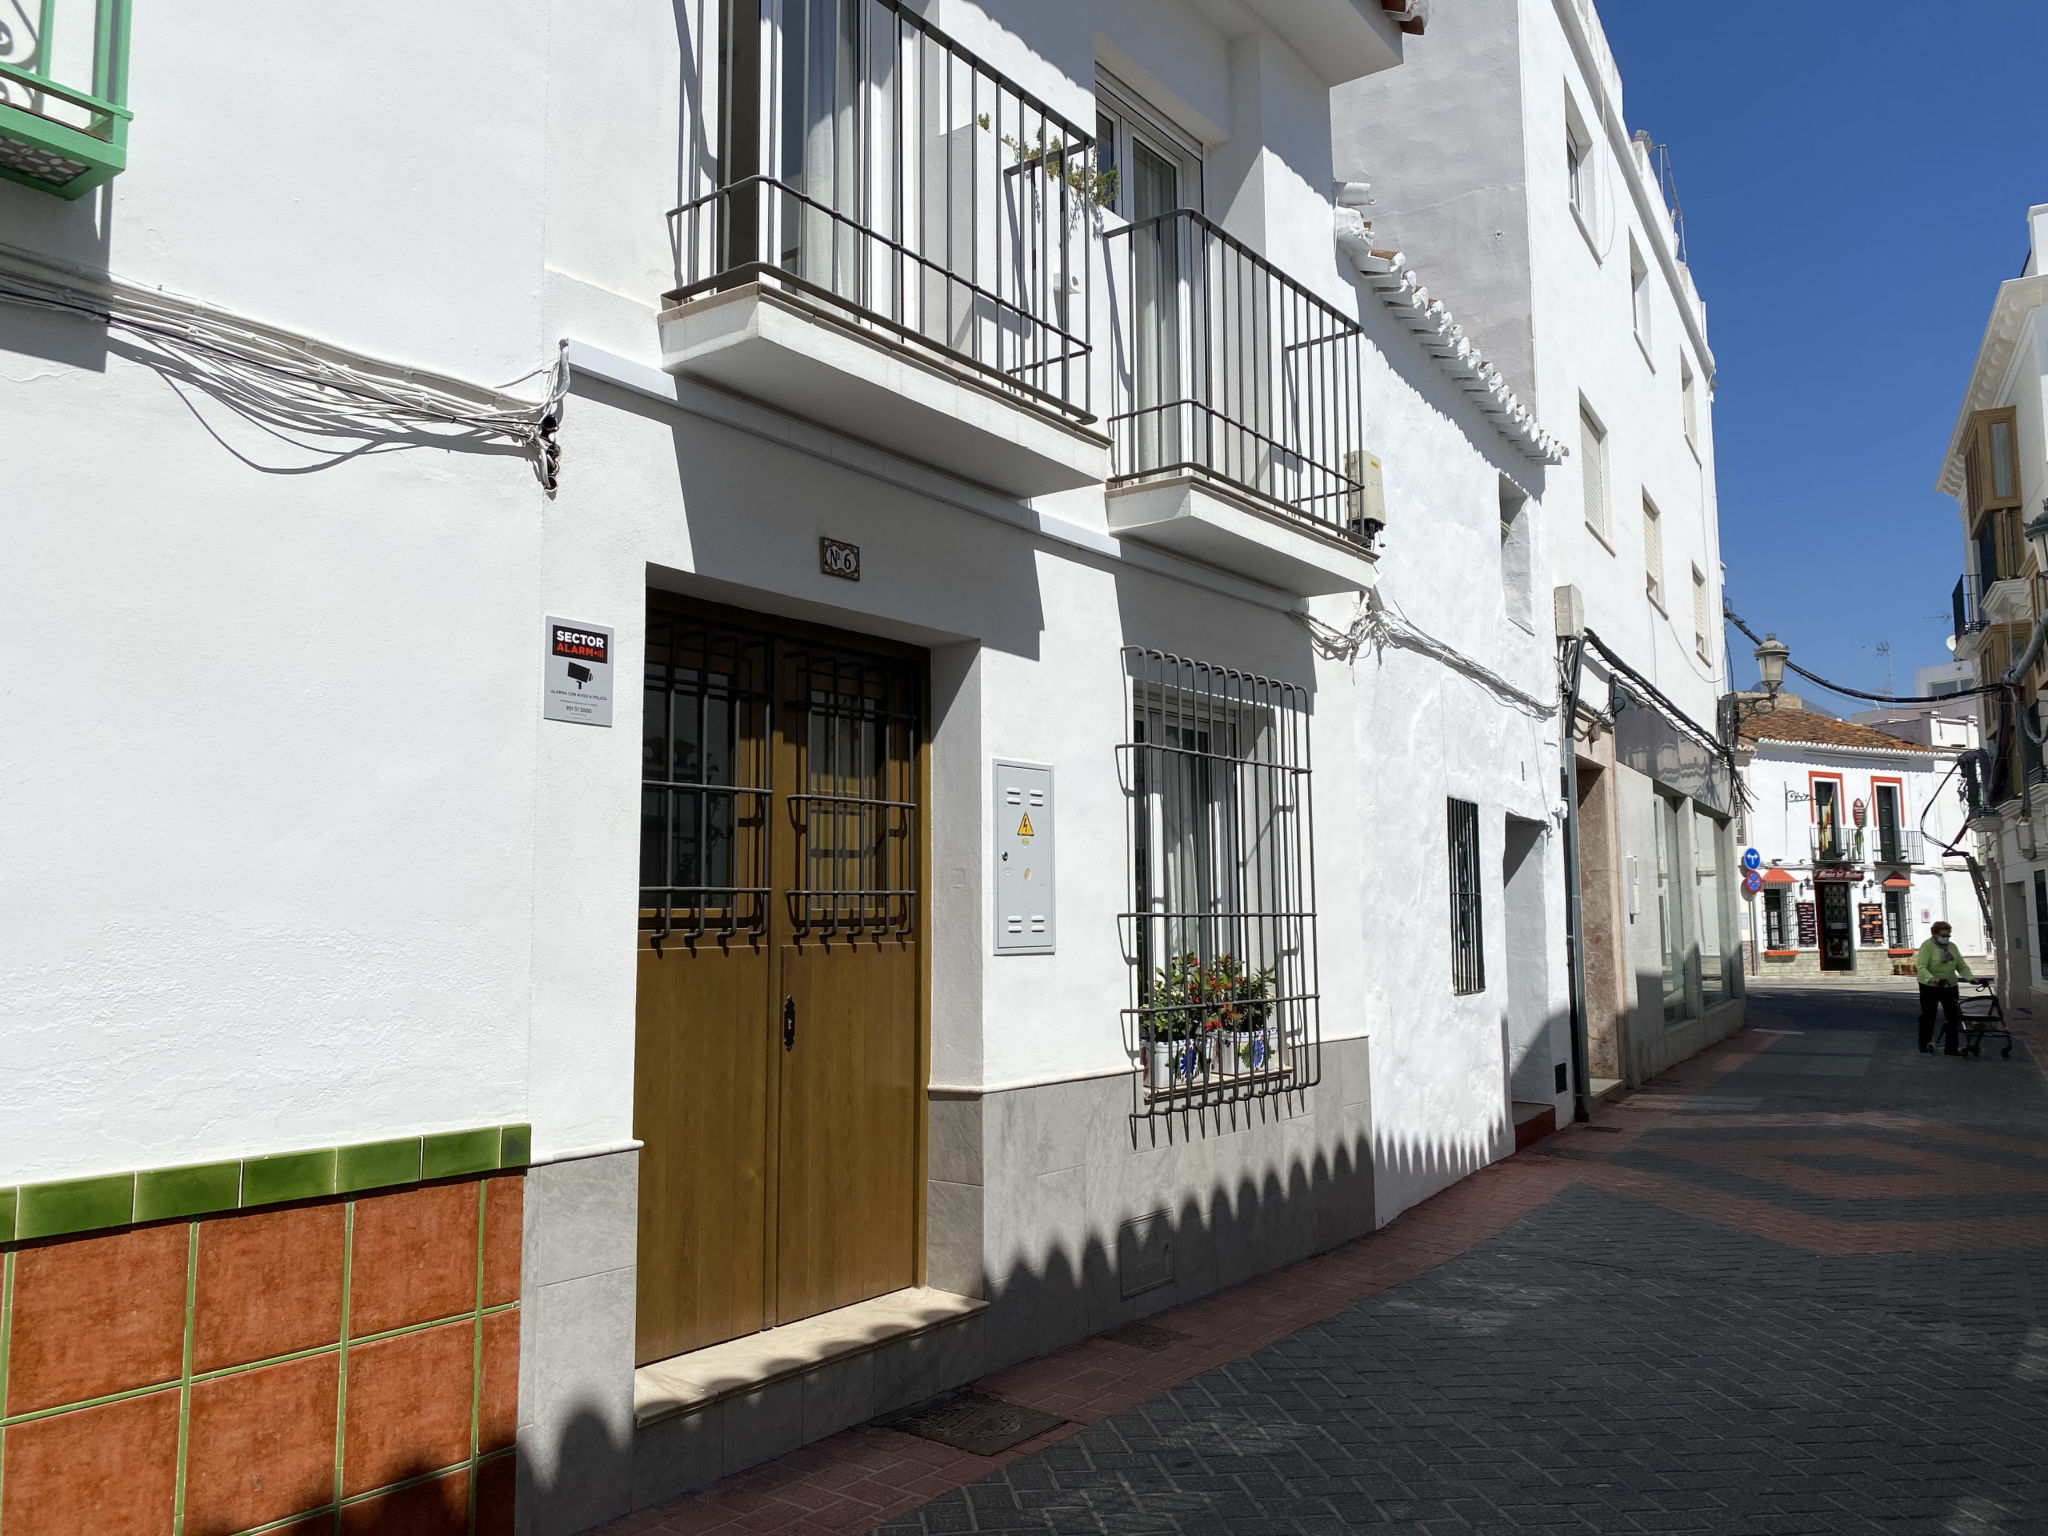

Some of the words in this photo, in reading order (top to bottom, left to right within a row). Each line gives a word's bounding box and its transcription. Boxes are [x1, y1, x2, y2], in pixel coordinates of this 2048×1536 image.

[844, 553, 852, 570] 6
[556, 630, 604, 649] SECTOR
[556, 641, 594, 657] ALARM
